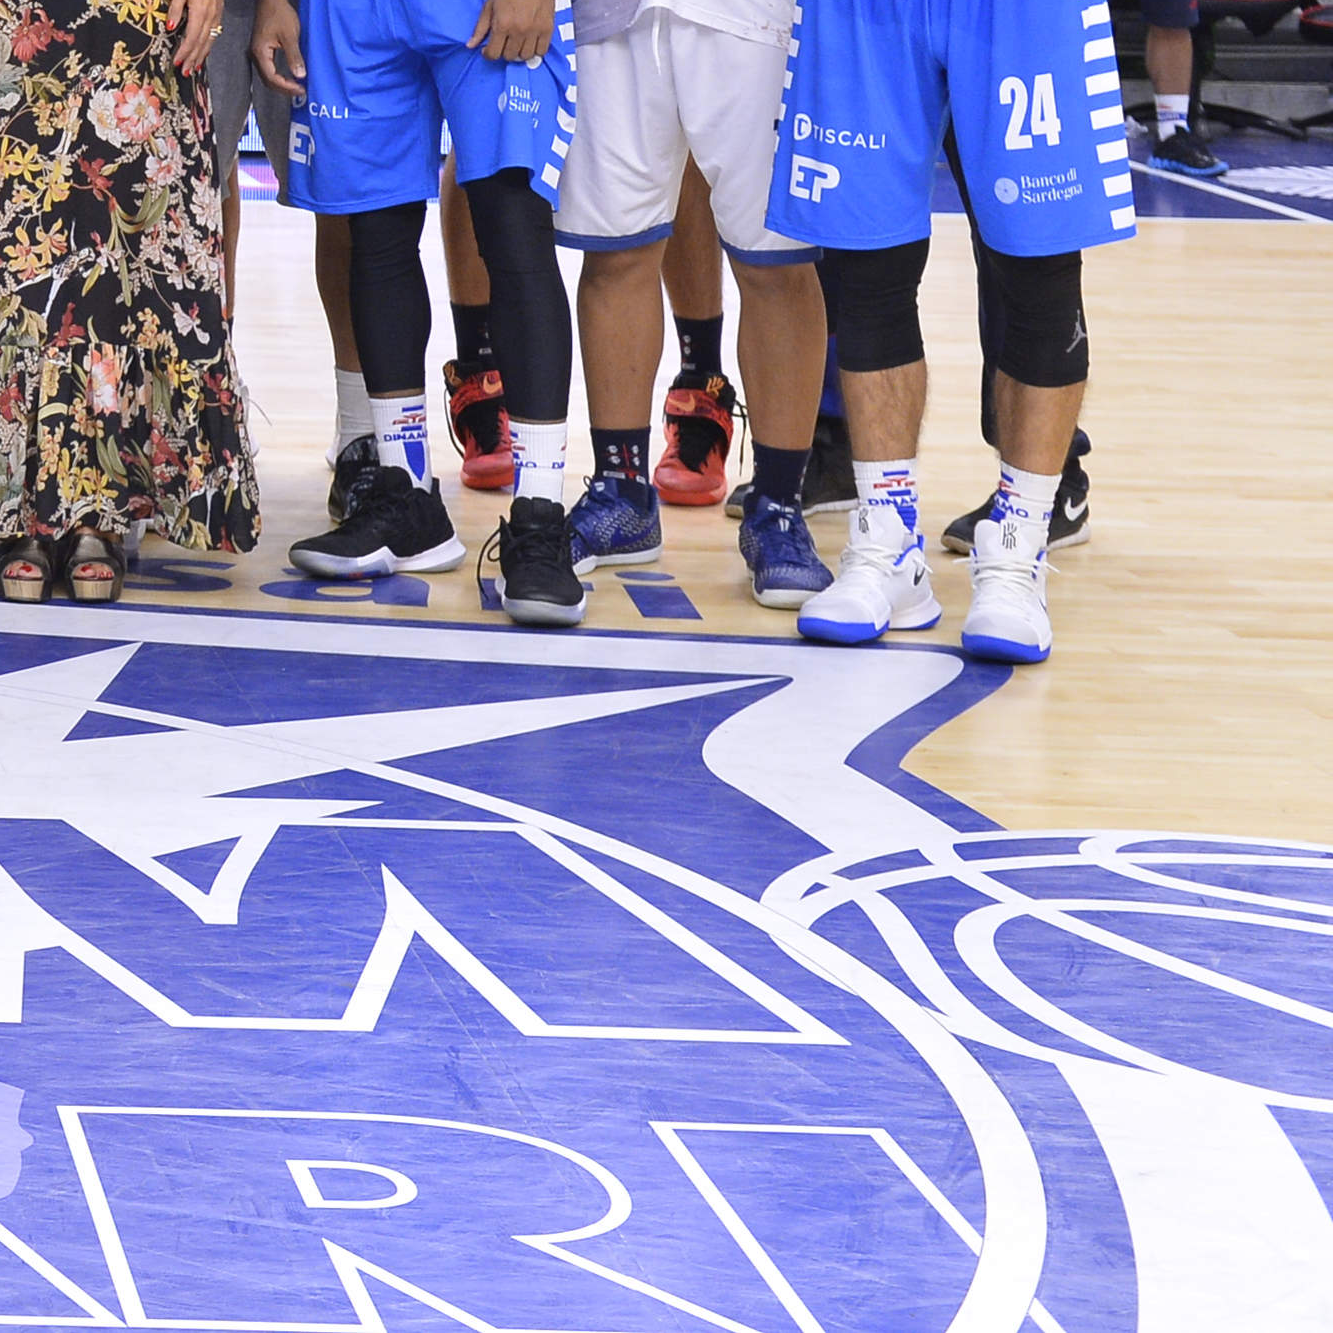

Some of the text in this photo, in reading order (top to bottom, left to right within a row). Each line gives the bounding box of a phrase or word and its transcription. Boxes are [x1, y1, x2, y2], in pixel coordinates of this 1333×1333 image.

[999, 74, 1060, 151] 24
[812, 128, 886, 149] TISCALI
[788, 154, 841, 203] EP
[1020, 168, 1078, 190] Banco di
[1020, 183, 1083, 206] Sardegna
